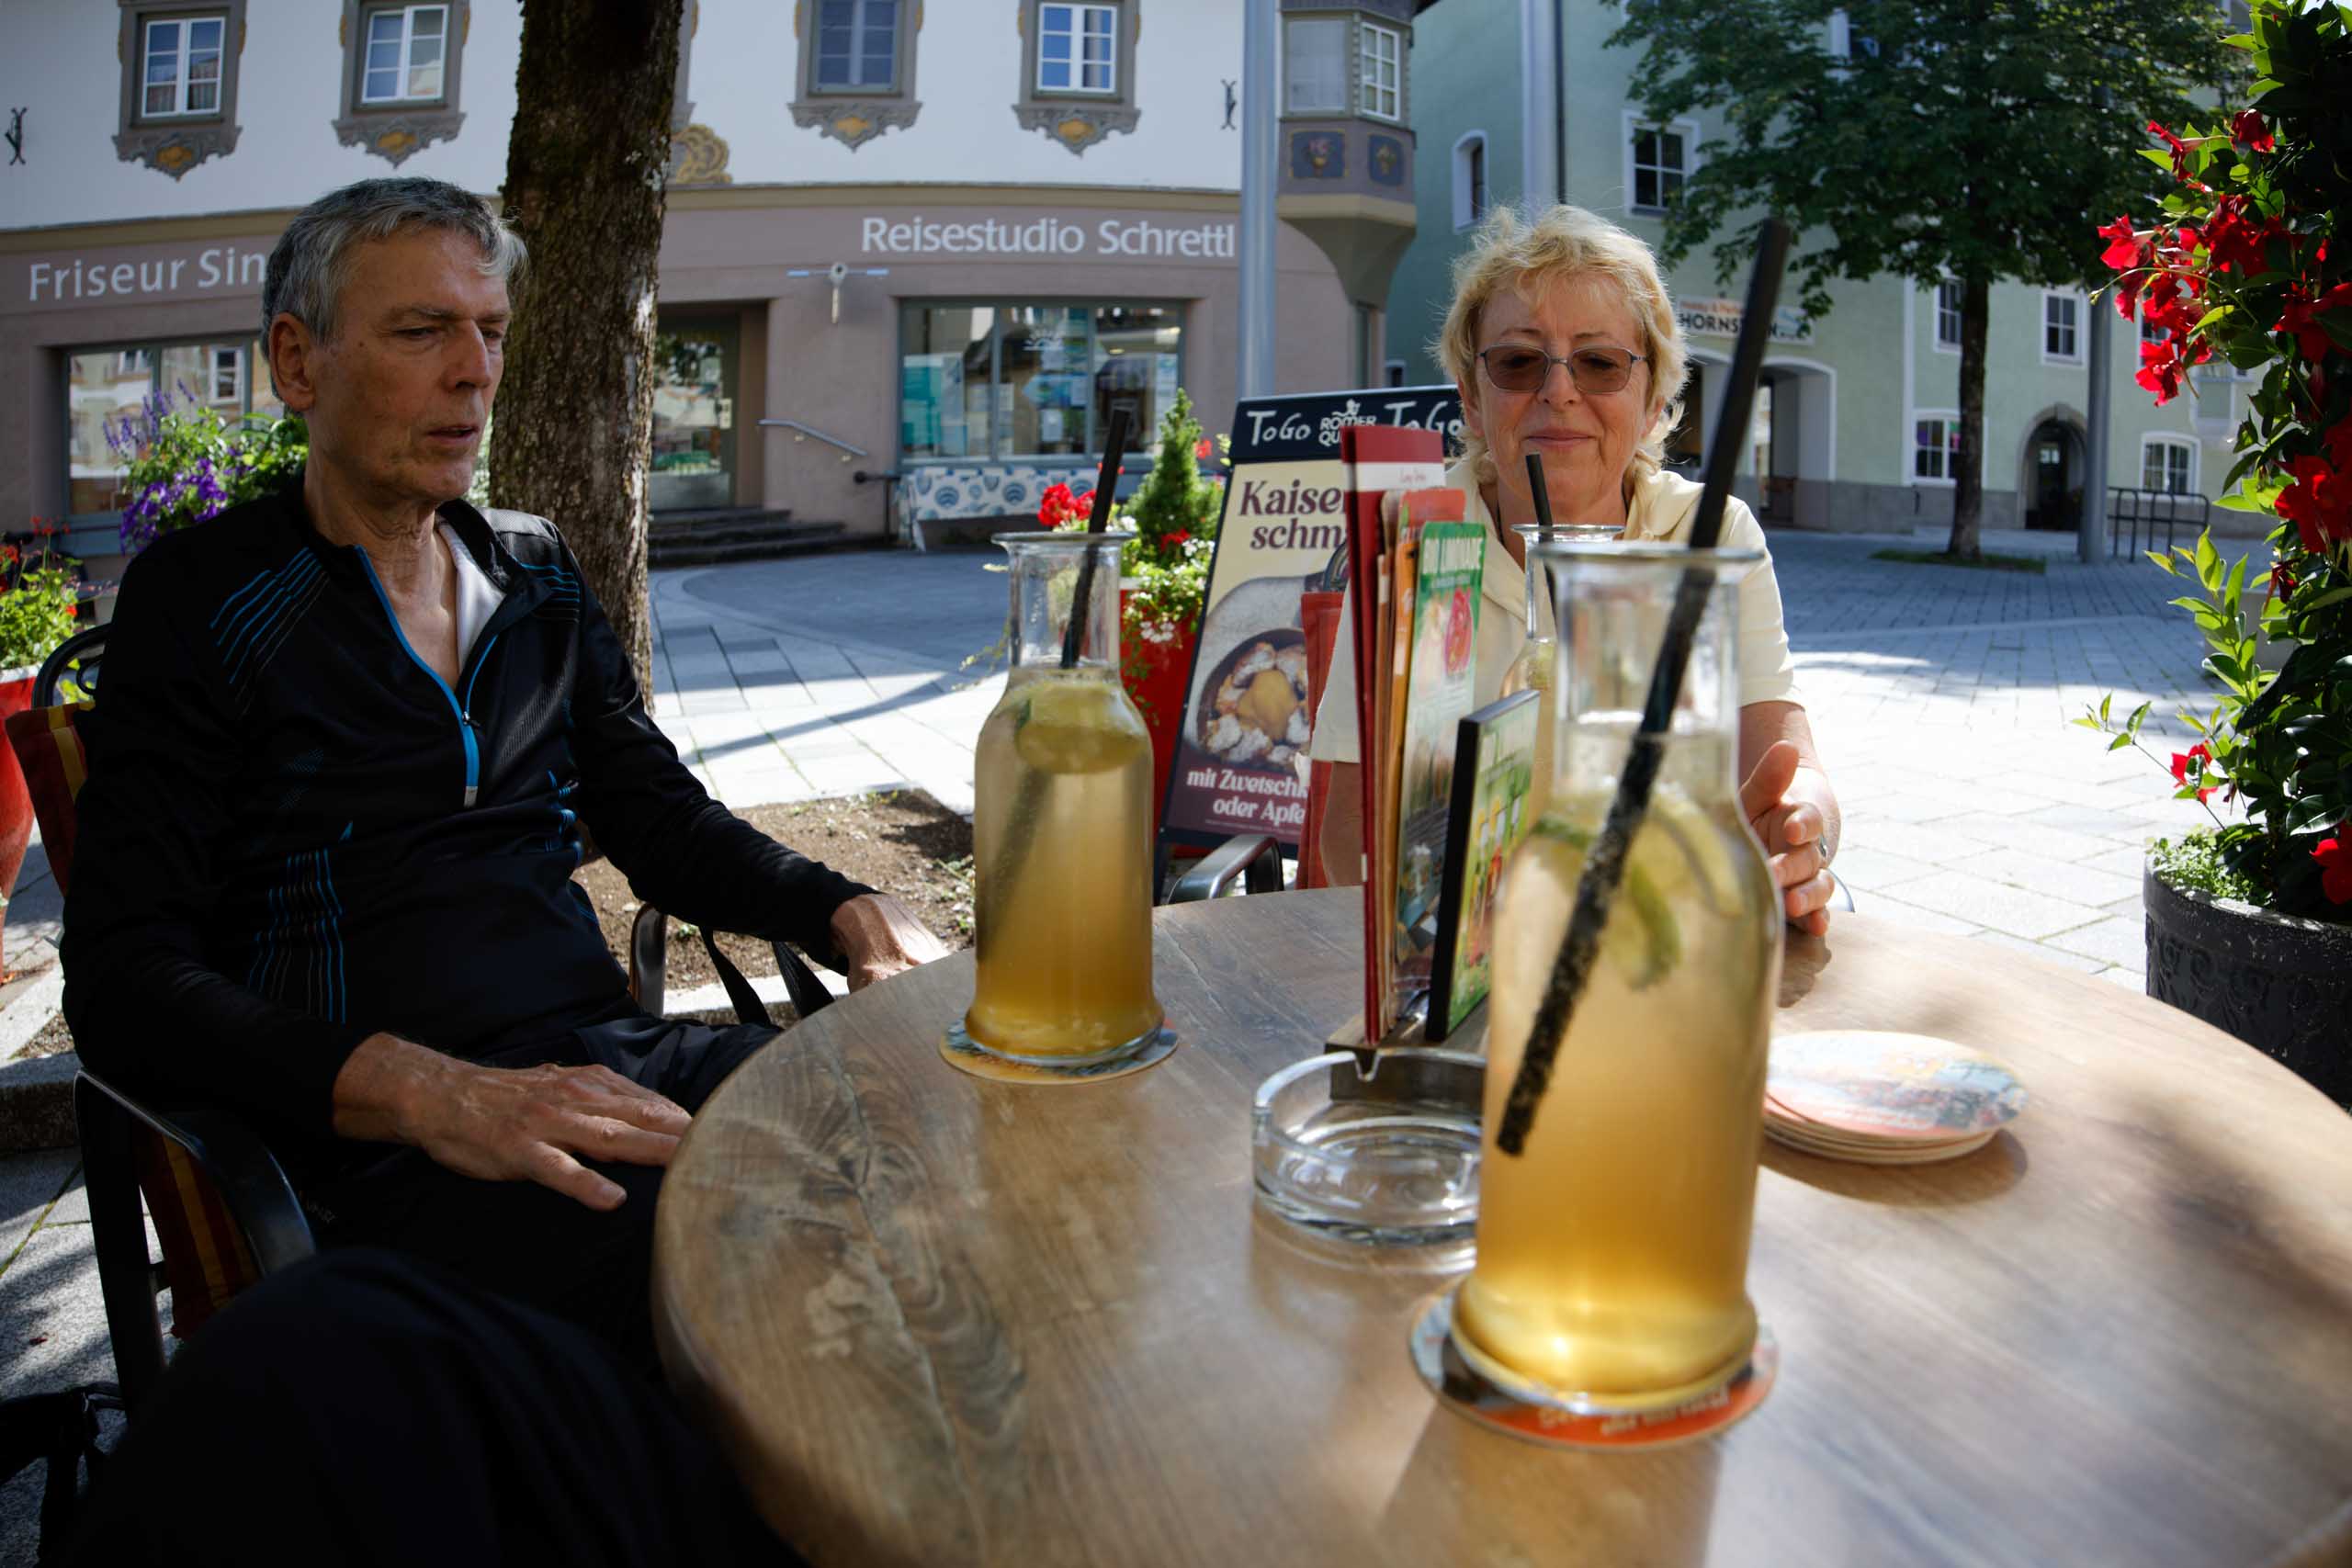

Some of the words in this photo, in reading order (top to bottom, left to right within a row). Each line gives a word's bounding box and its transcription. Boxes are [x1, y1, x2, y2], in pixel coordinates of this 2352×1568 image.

[861, 217, 1085, 253] Reisestudio
[1098, 220, 1235, 258] Schrettl
[29, 259, 186, 301] Friseur
[198, 247, 266, 288] Sin
[1680, 312, 1778, 338] HORNSN
[1318, 431, 1341, 446] QU
[1238, 479, 1346, 515] Kaise
[1250, 517, 1343, 550] schm
[1187, 768, 1217, 787] mit
[1219, 769, 1308, 799] Zwetschk
[1213, 796, 1259, 818] oder
[1261, 800, 1306, 827] Apfe
